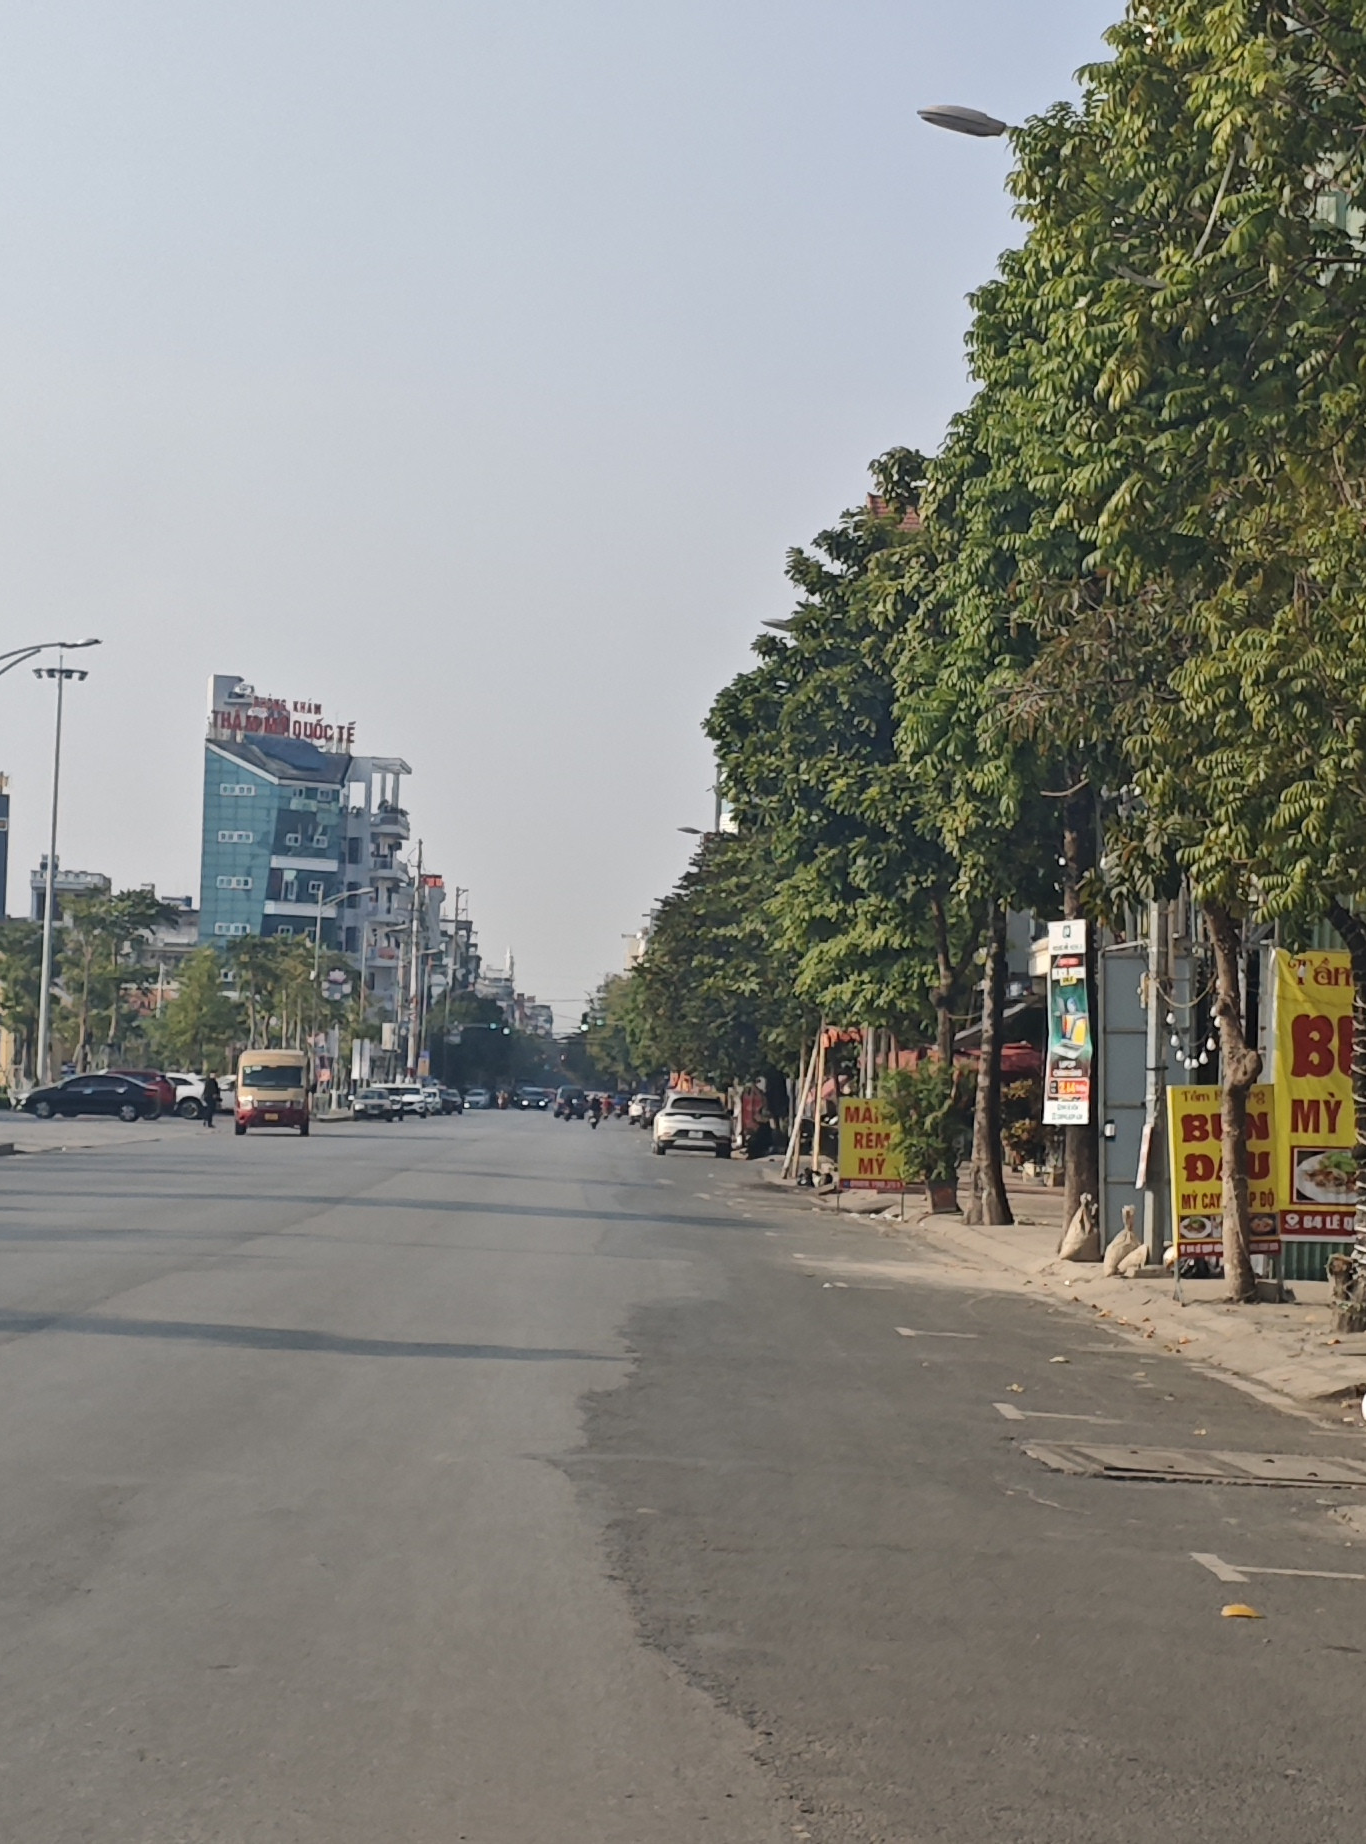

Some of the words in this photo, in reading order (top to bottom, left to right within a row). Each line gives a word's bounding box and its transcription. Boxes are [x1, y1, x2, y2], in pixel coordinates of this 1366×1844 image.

[292, 698, 322, 715] KHÁM
[292, 717, 334, 742] QUỐC
[336, 721, 357, 744] TẾ
[1291, 1092, 1342, 1134] MỲ
[1182, 1190, 1198, 1210] MỲ
